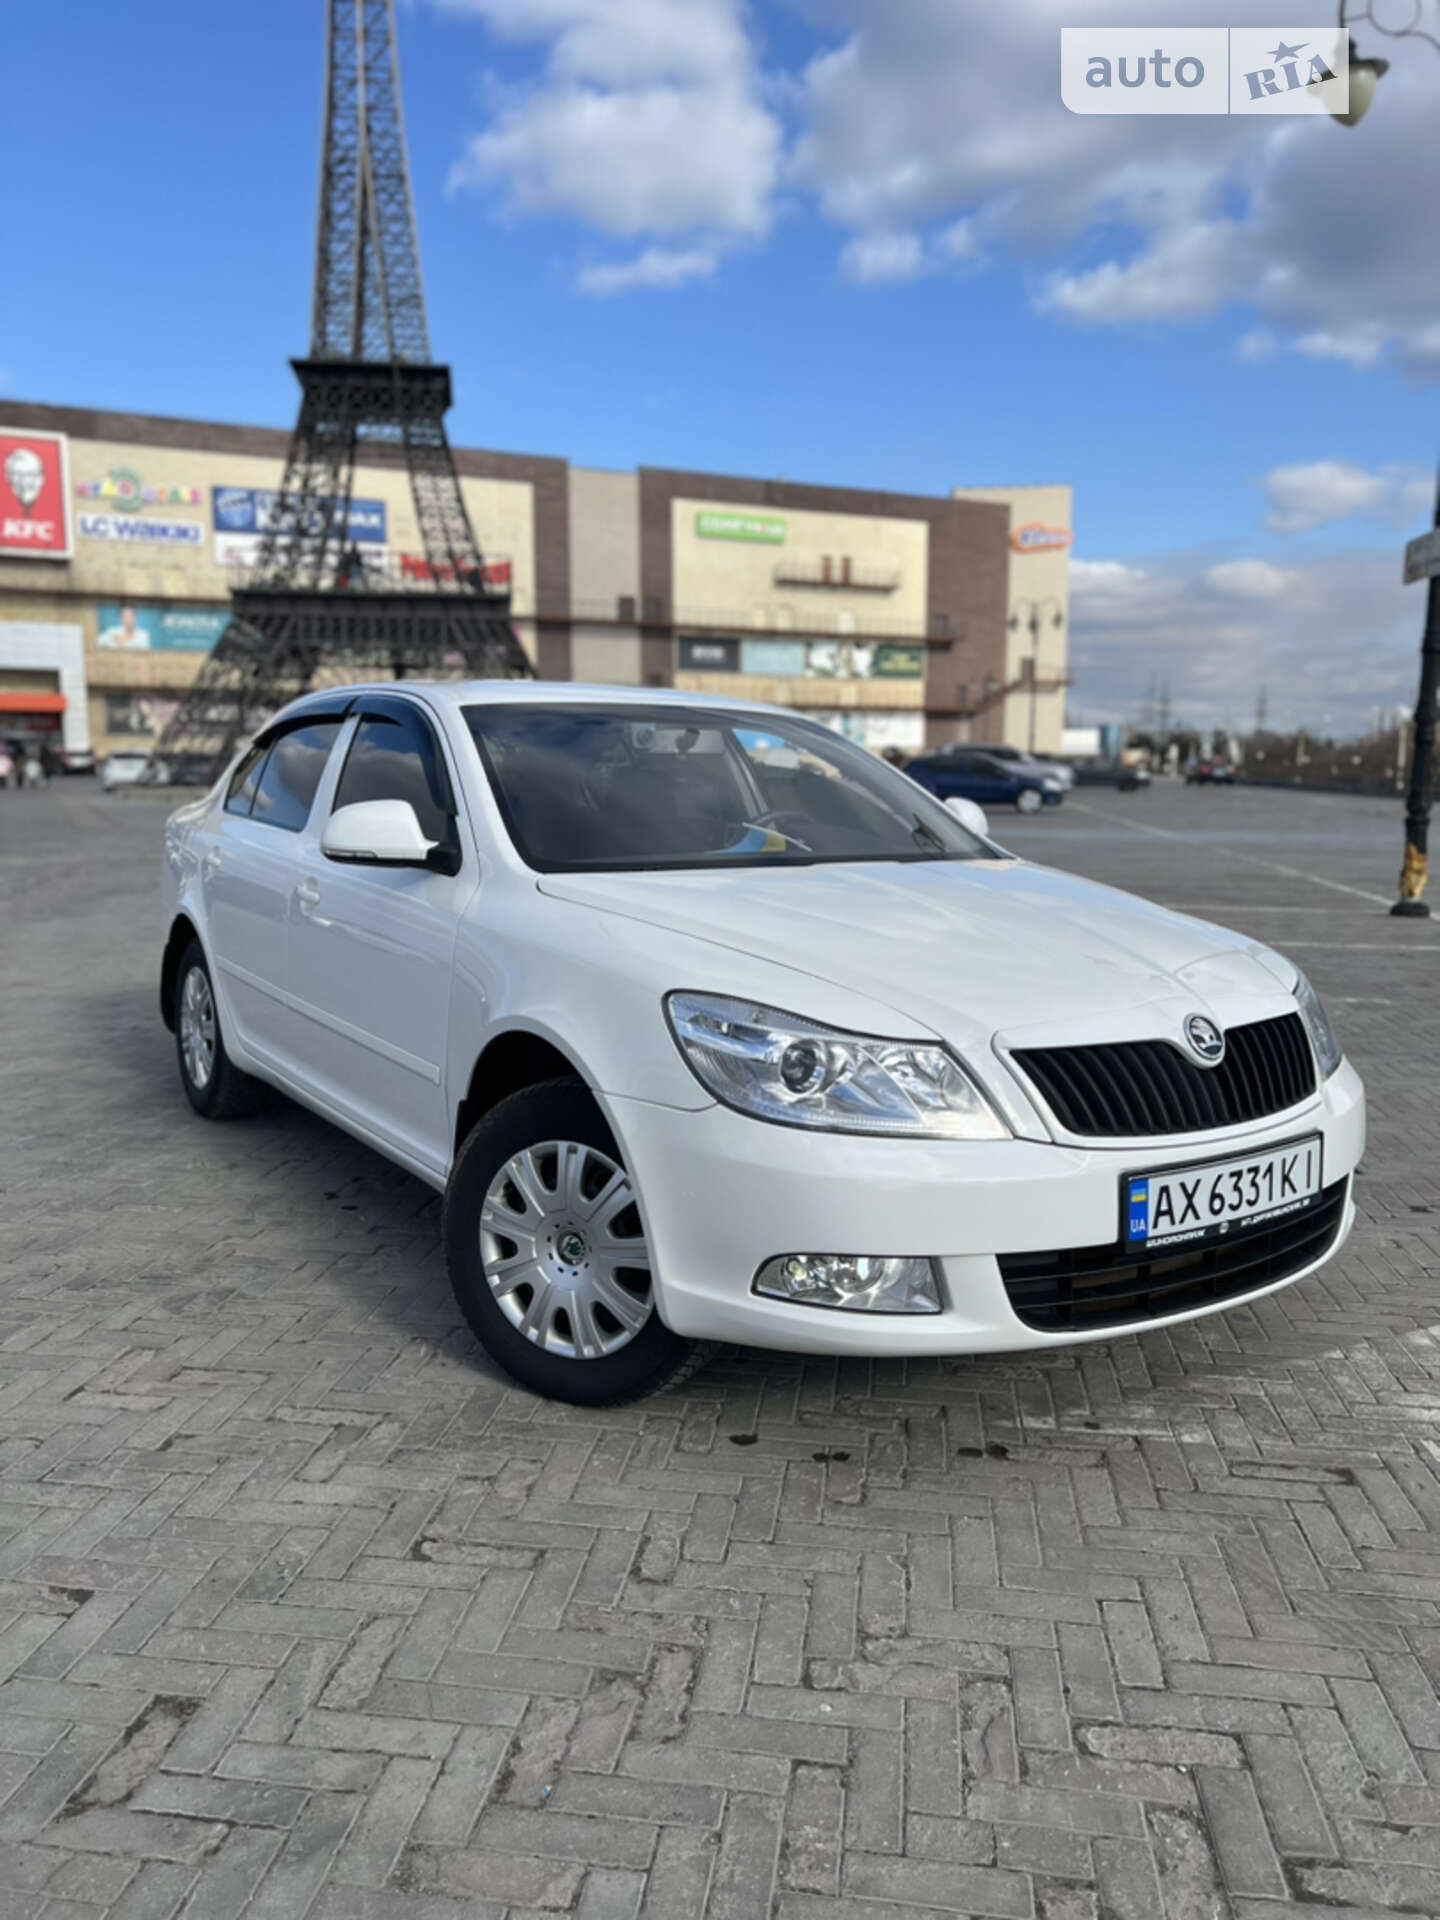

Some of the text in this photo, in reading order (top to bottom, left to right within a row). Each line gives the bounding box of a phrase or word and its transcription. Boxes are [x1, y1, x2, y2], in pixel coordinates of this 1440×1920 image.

[3, 518, 55, 541] KFC
[80, 517, 109, 536] LC
[1208, 1161, 1275, 1217] 6331
[1130, 1218, 1148, 1233] UA
